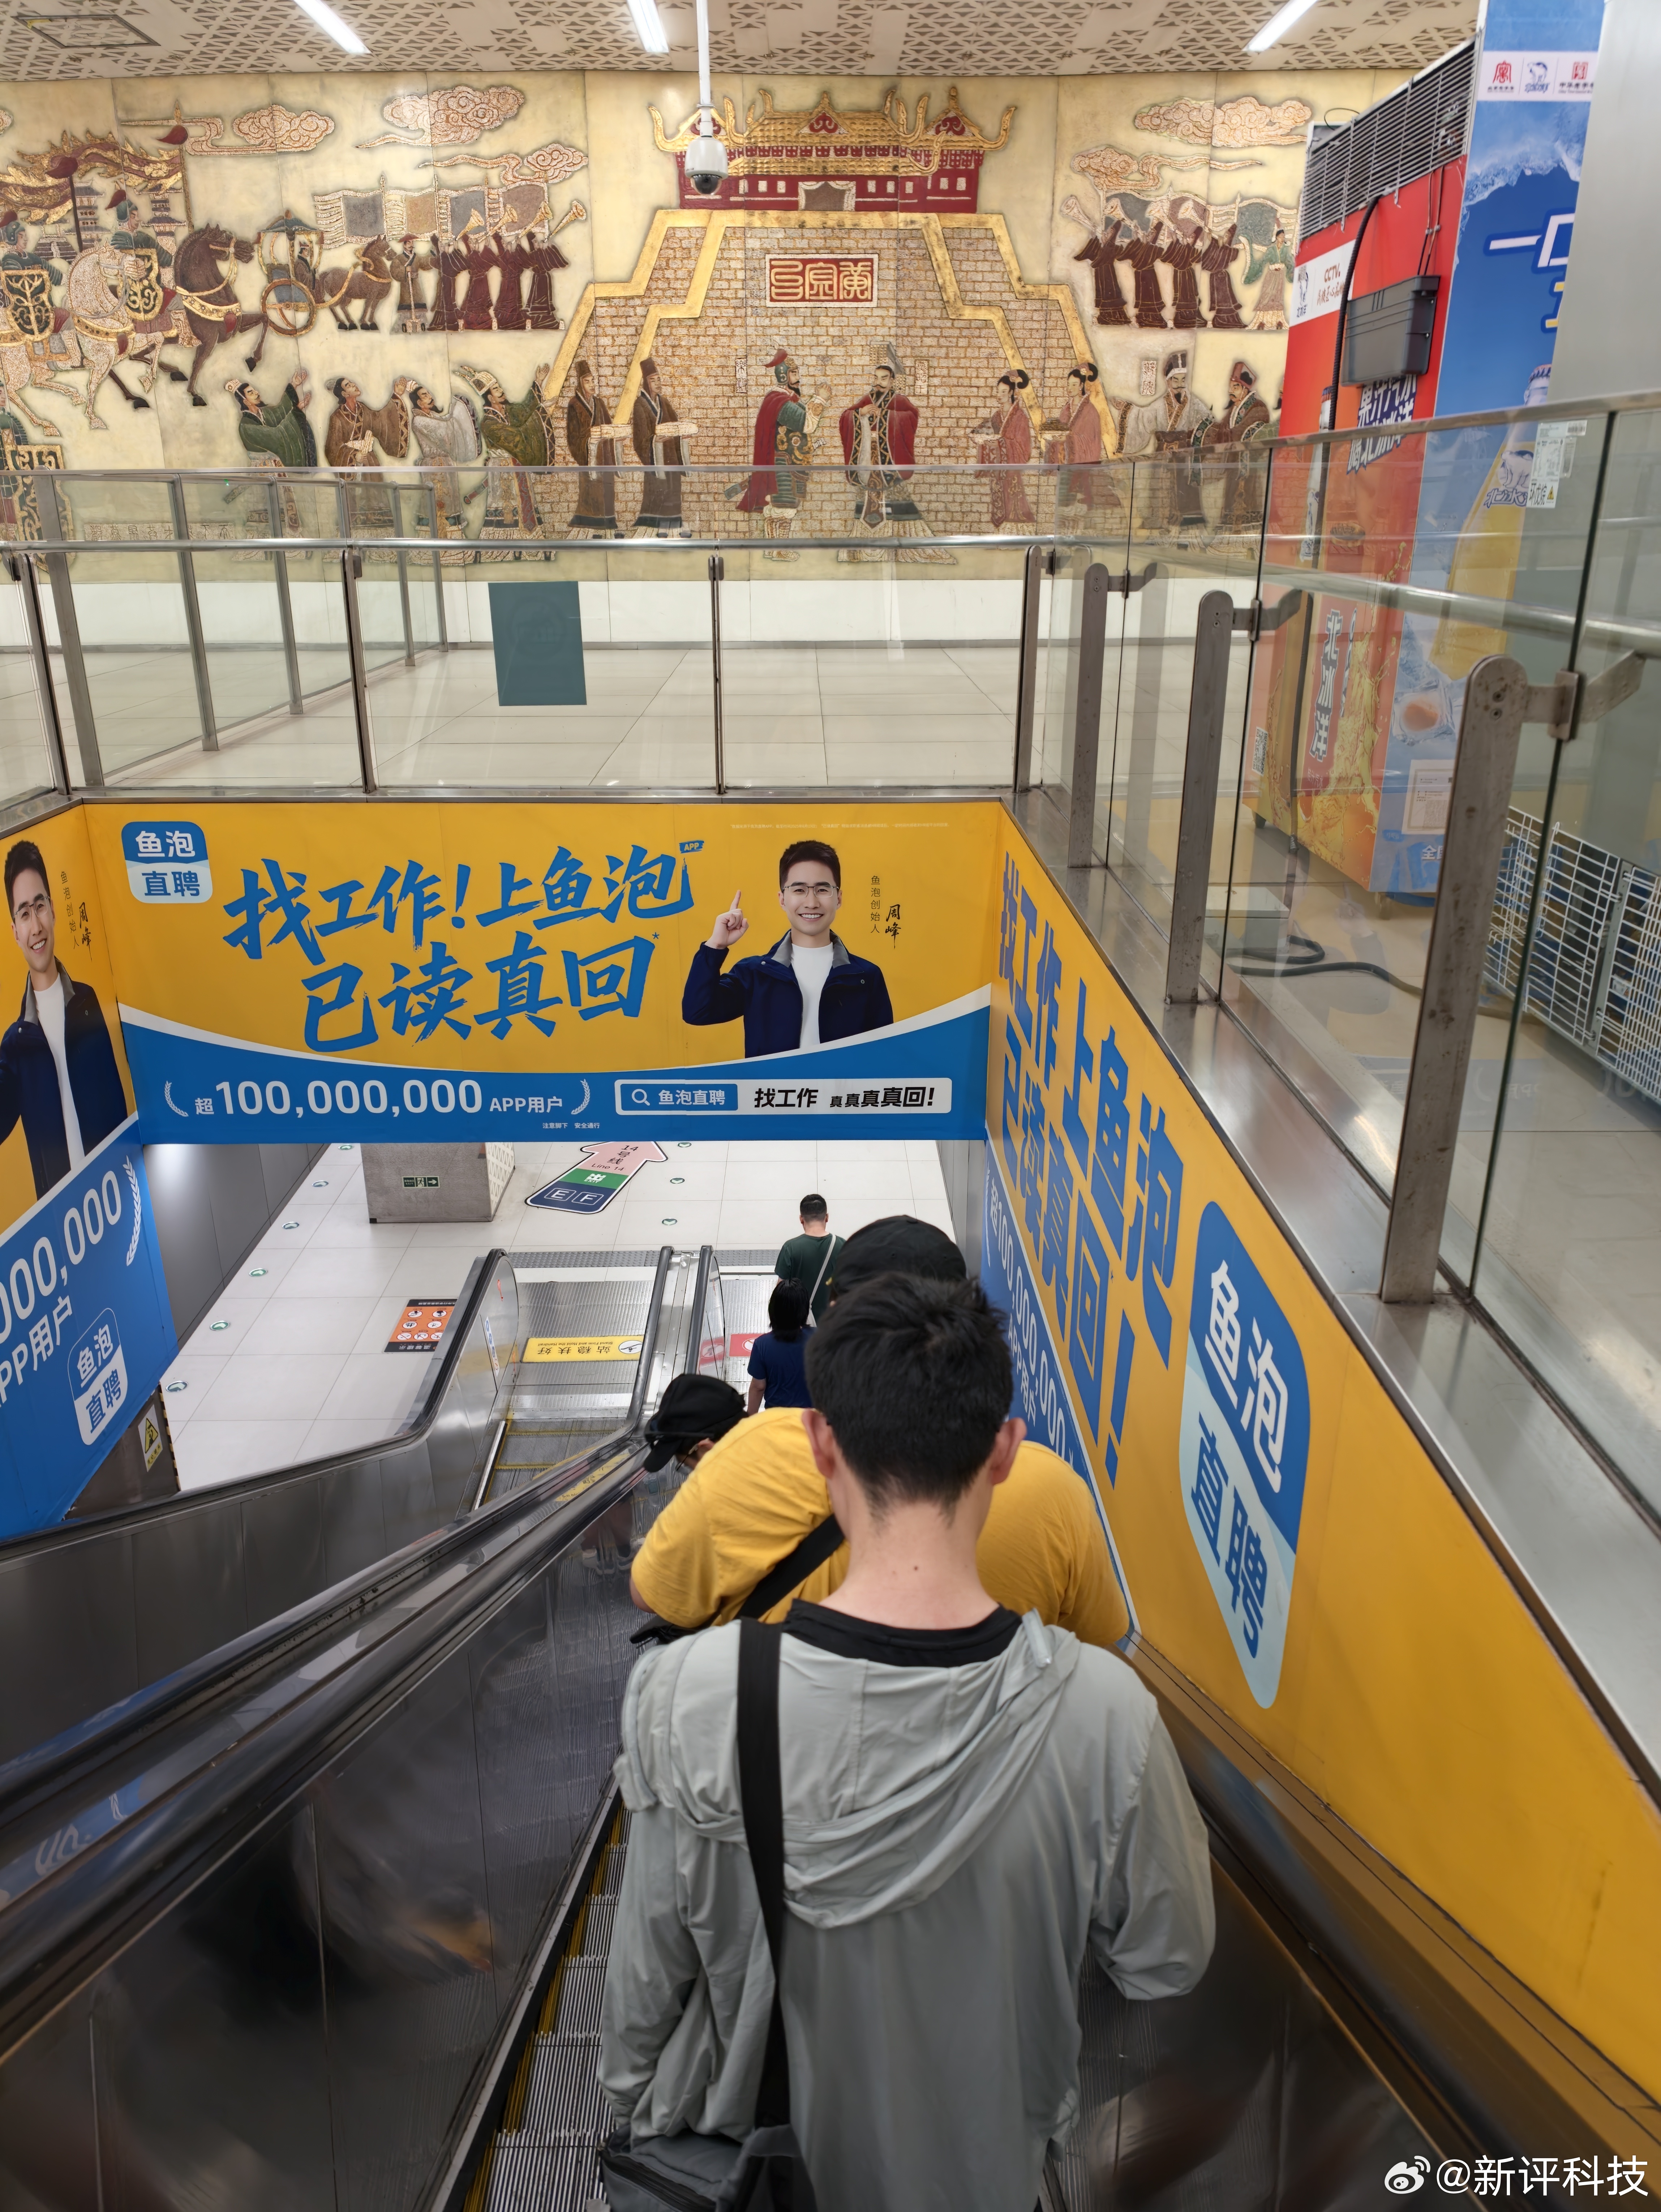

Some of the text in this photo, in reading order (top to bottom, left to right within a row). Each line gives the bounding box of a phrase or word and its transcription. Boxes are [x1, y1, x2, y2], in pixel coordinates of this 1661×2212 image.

[1310, 614, 1342, 759] 北冰洋
[135, 831, 196, 857] 鱼泡
[684, 843, 700, 851] APP
[60, 871, 80, 949] 鱼泡创始人
[142, 871, 200, 896] 直聘
[870, 875, 881, 934] 鱼泡创始人
[79, 901, 93, 963] 周峰
[885, 904, 902, 949] 周峰
[301, 931, 656, 1053] 已读真回
[195, 1079, 562, 1118] 超 100,000,000 APP用户
[658, 1089, 725, 1105] 鱼泡直聘
[754, 1088, 819, 1108] 找工作
[550, 1190, 570, 1199] E
[0, 1295, 72, 1407] PP用户
[77, 1324, 113, 1388] 鱼泡
[537, 1346, 611, 1355] 站稳扶好
[1008, 1313, 1037, 1427] APP用户
[1205, 1259, 1288, 1493] 鱼泡
[85, 1368, 121, 1426] 直聘
[1191, 1411, 1267, 1659] 直聘
